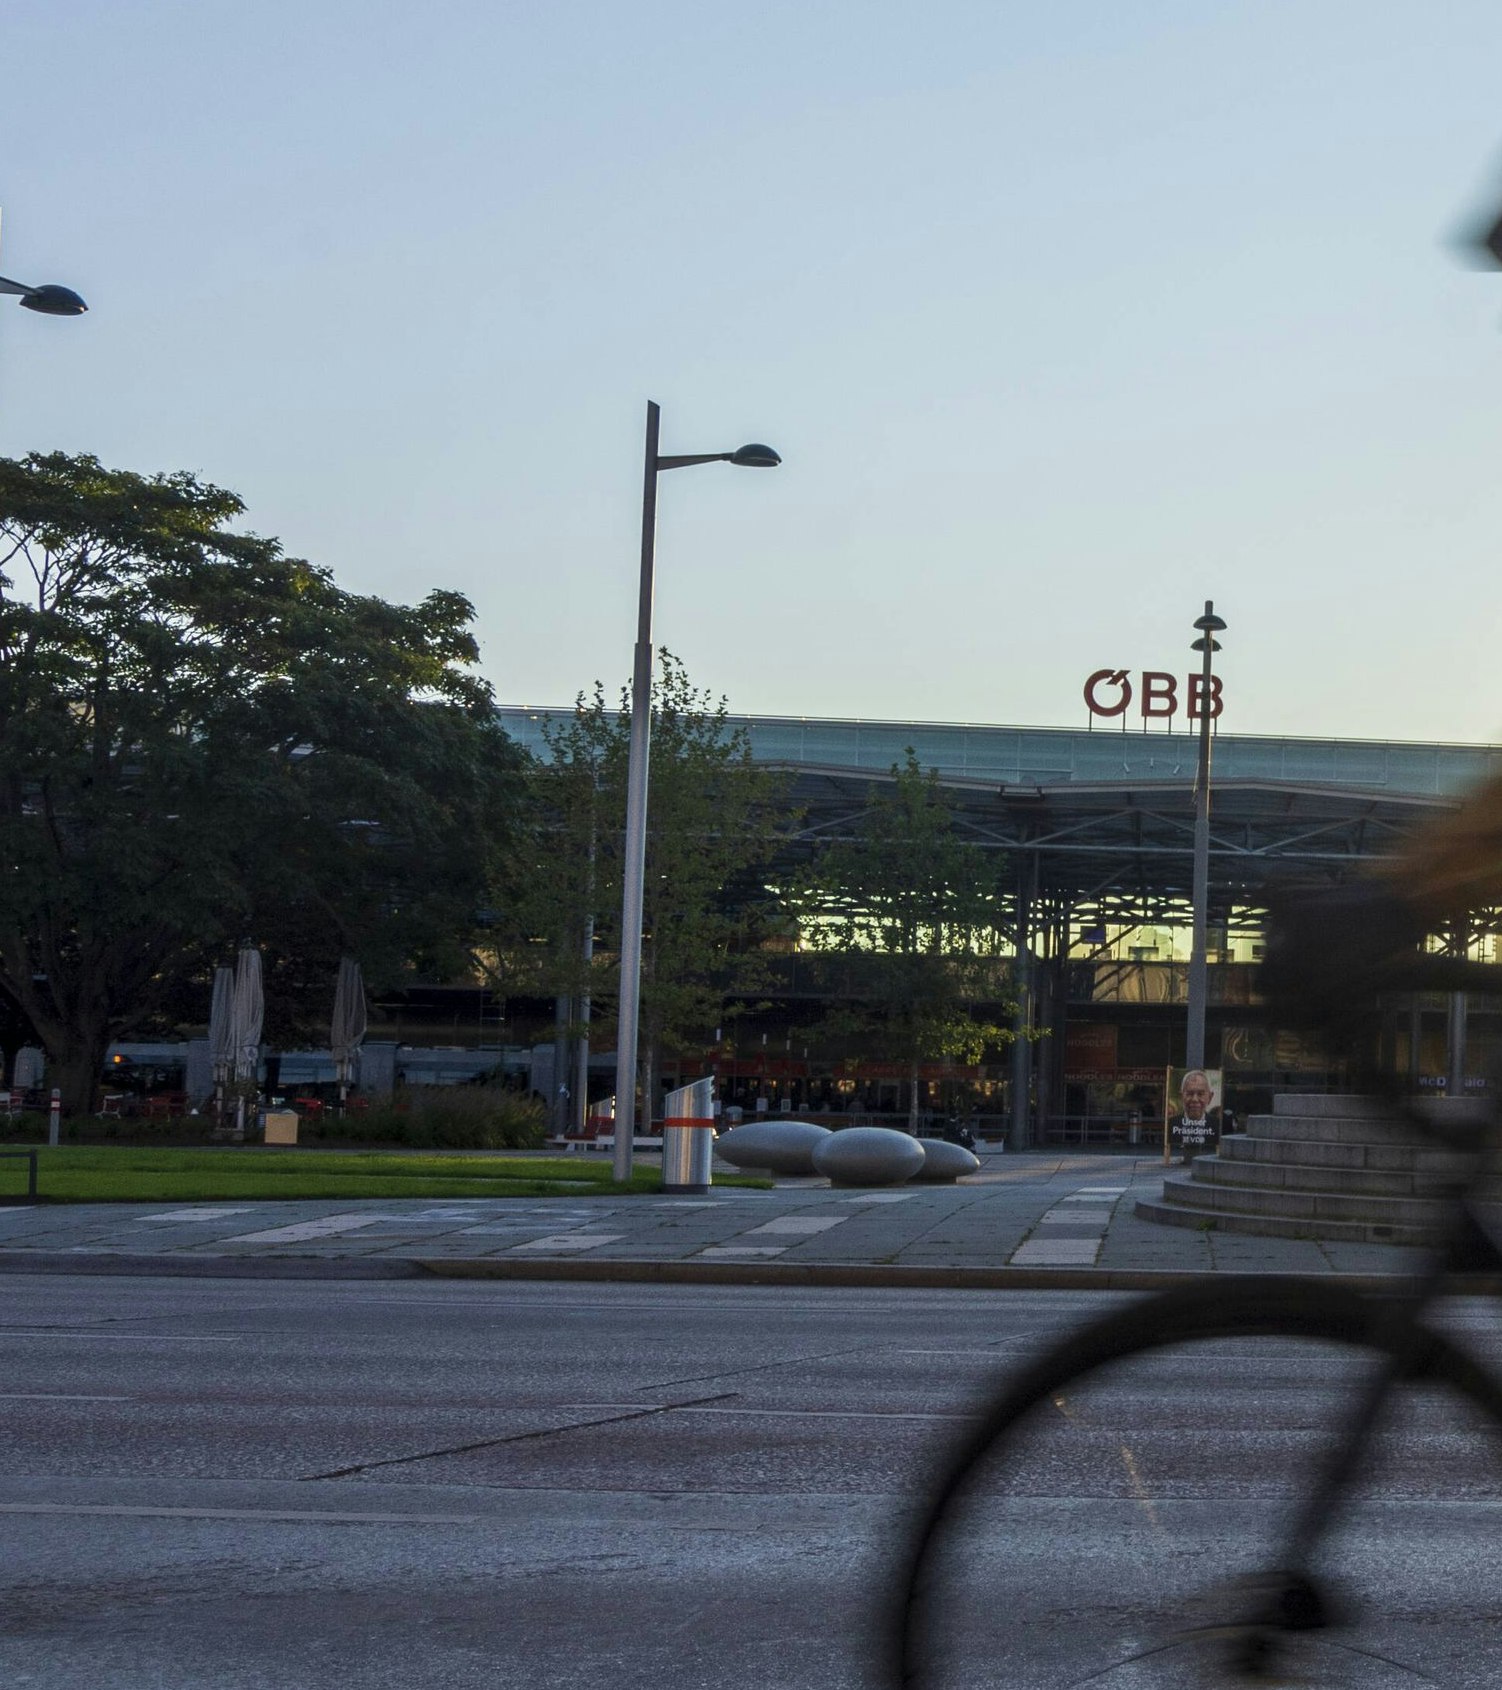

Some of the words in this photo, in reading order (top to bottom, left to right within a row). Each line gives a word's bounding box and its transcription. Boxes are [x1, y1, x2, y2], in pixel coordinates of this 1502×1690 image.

[1084, 669, 1223, 718] ÖBB
[1182, 1118, 1207, 1126] Unser
[1172, 1126, 1215, 1135] Präsident.
